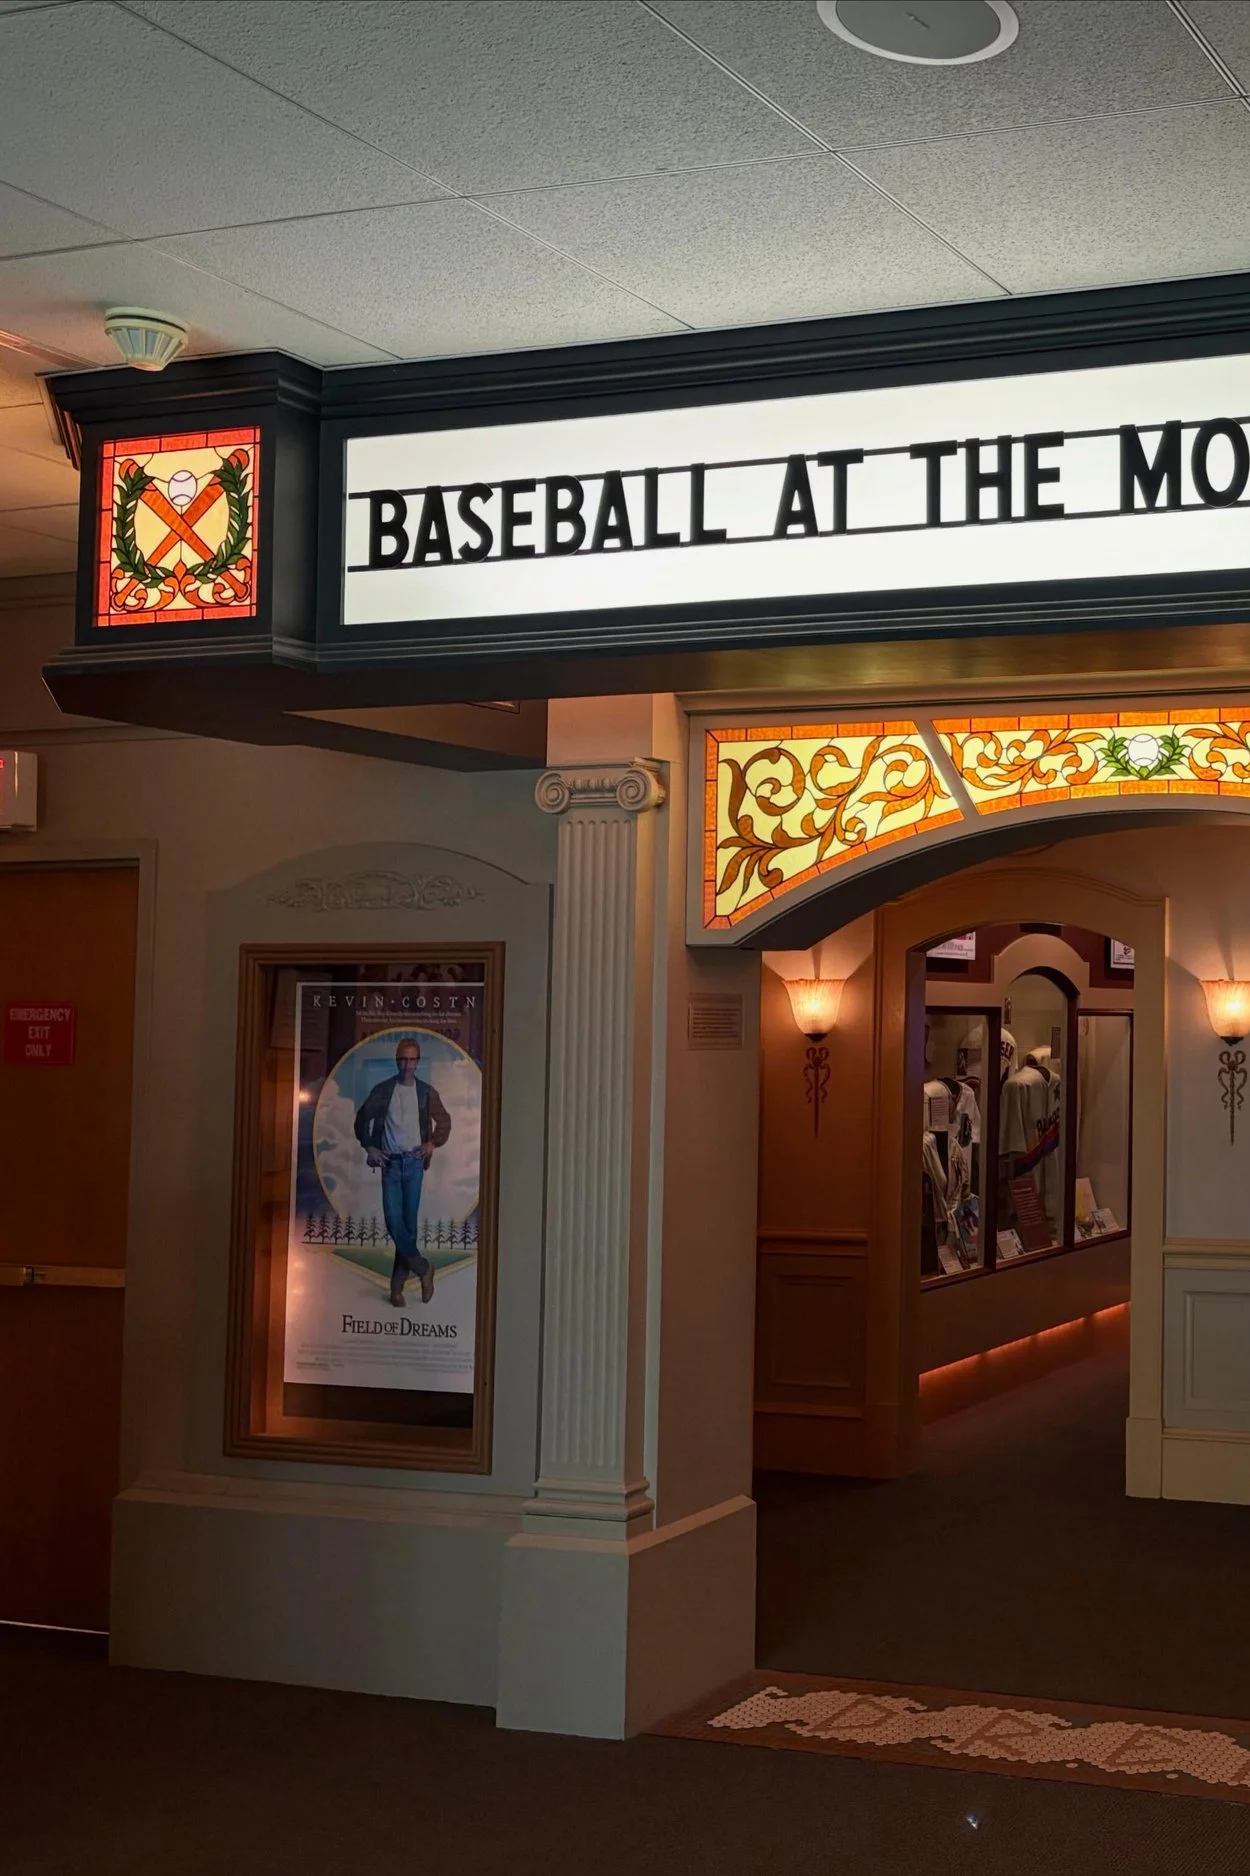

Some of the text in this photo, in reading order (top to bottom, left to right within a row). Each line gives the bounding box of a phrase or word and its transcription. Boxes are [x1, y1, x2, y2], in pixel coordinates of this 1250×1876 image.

[368, 463, 727, 569] BASEBALL
[773, 448, 863, 540] AT
[909, 432, 1066, 528] THE
[312, 995, 385, 1008] KEVIN
[28, 1026, 51, 1039] EXIT
[25, 1044, 52, 1057] ONLY
[341, 1314, 458, 1338] FIELD OF DREAMS
